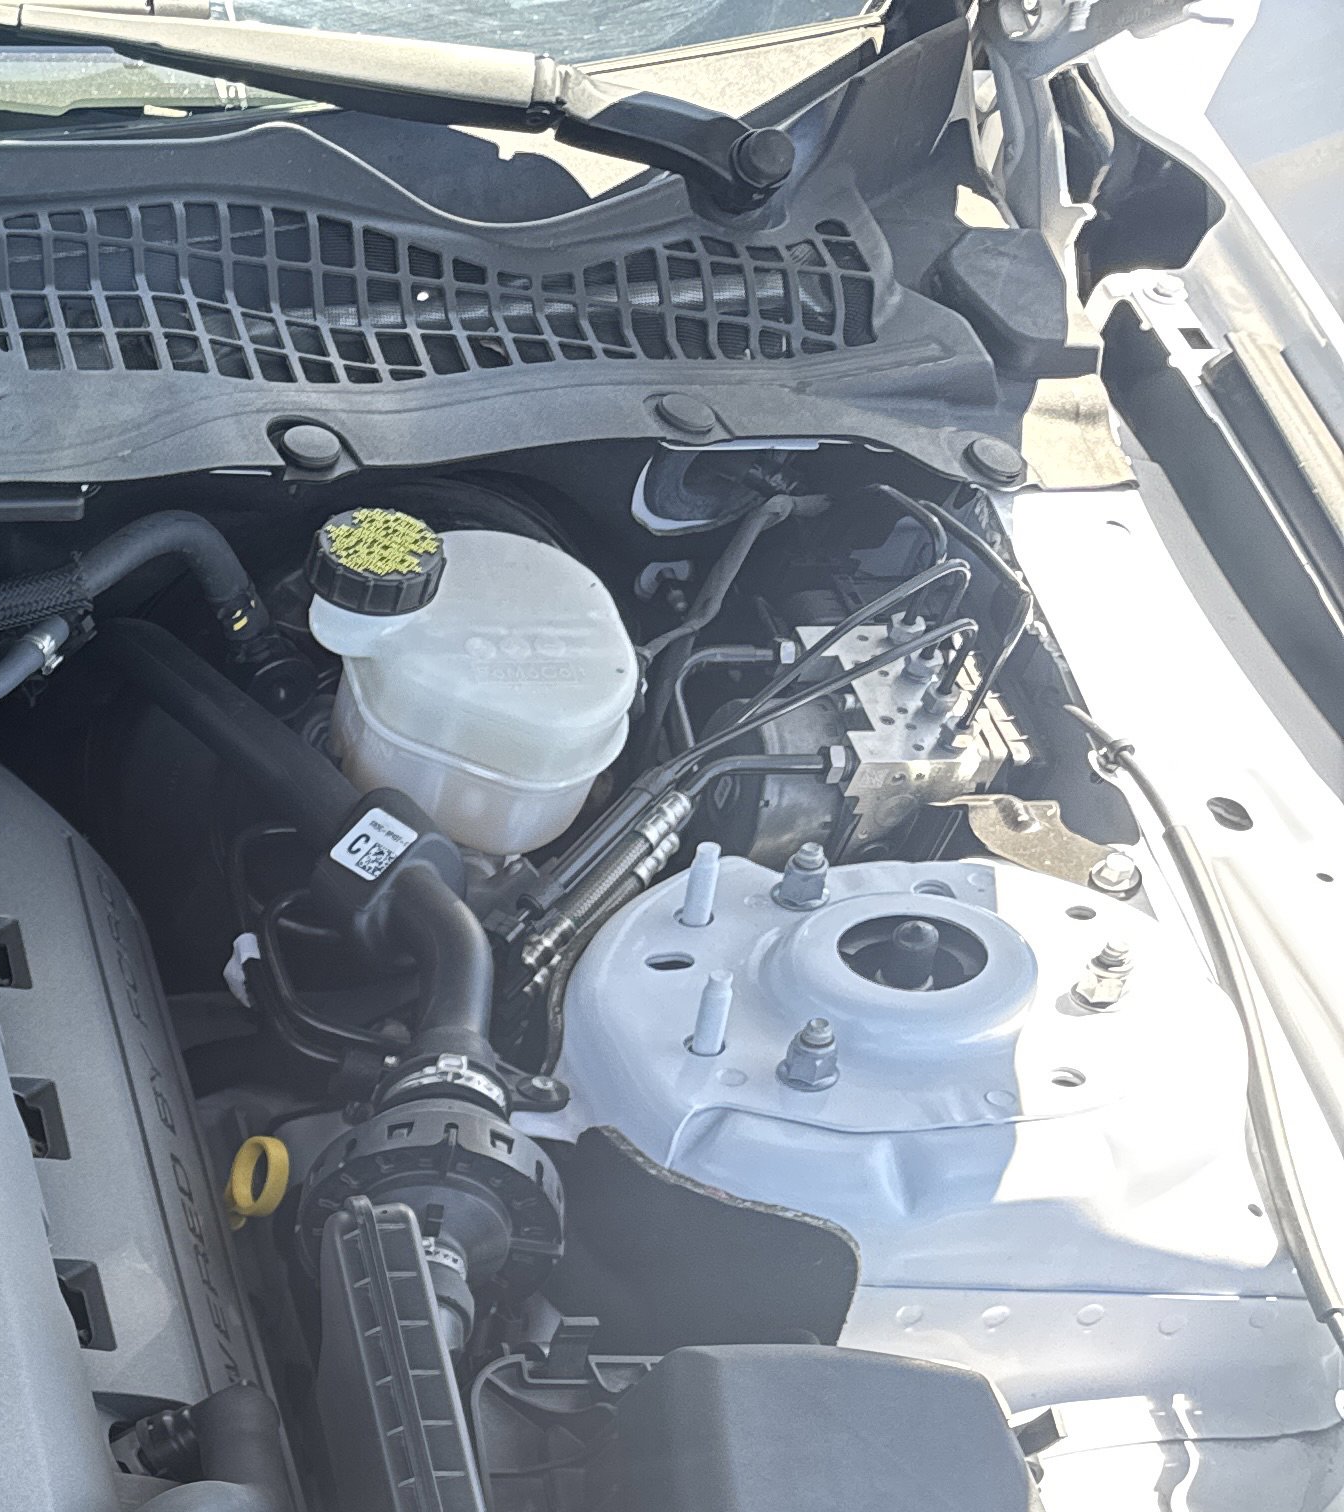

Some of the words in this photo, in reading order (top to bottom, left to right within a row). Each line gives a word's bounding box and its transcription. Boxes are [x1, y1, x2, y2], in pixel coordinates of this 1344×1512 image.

[347, 833, 370, 857] C
[93, 871, 150, 1030] FORD
[138, 1040, 178, 1136] BY
